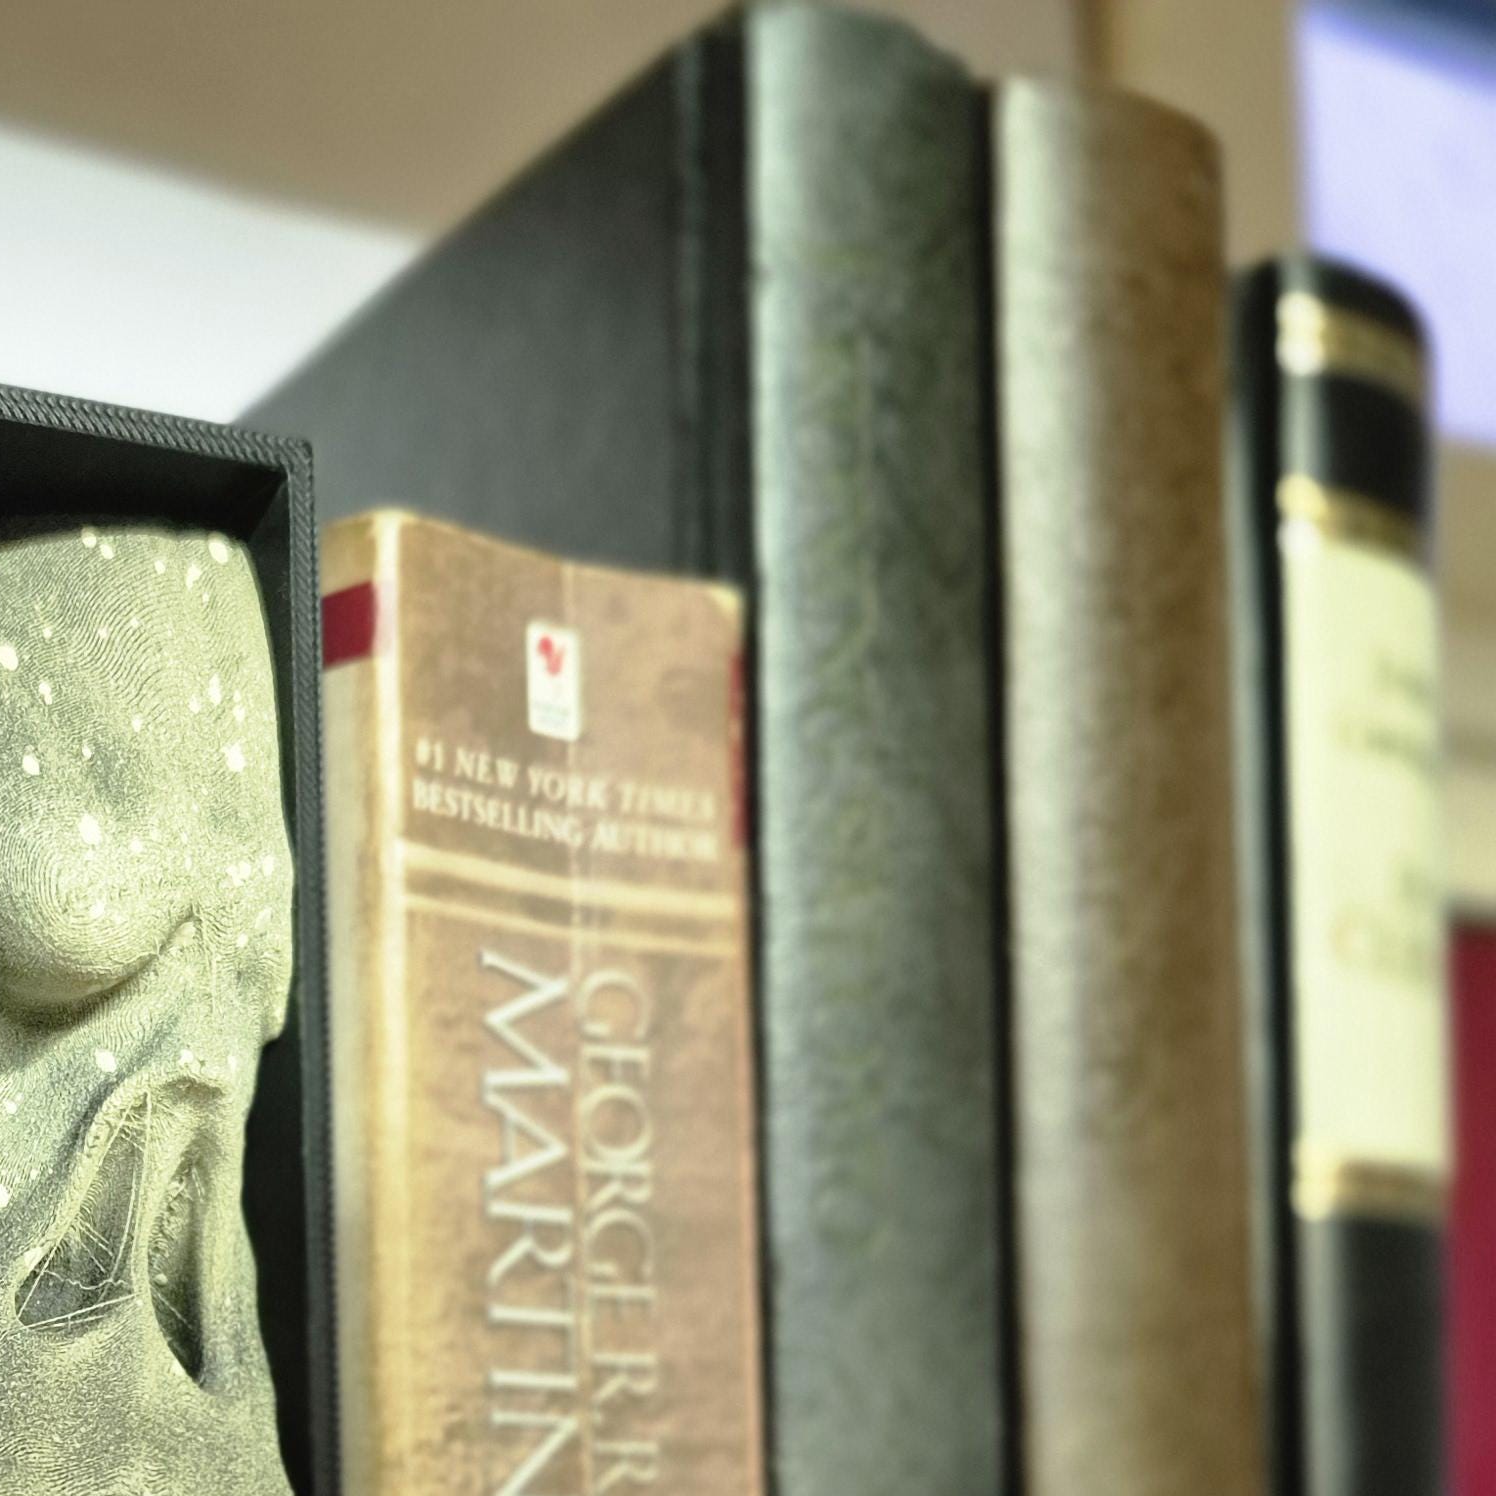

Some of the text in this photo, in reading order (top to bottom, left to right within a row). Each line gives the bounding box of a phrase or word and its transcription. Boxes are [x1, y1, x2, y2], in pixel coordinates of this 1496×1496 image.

[411, 778, 584, 848] BESTSELLING
[453, 747, 520, 788] NEW
[526, 766, 608, 810] YORK
[578, 967, 657, 1322] GEORGE
